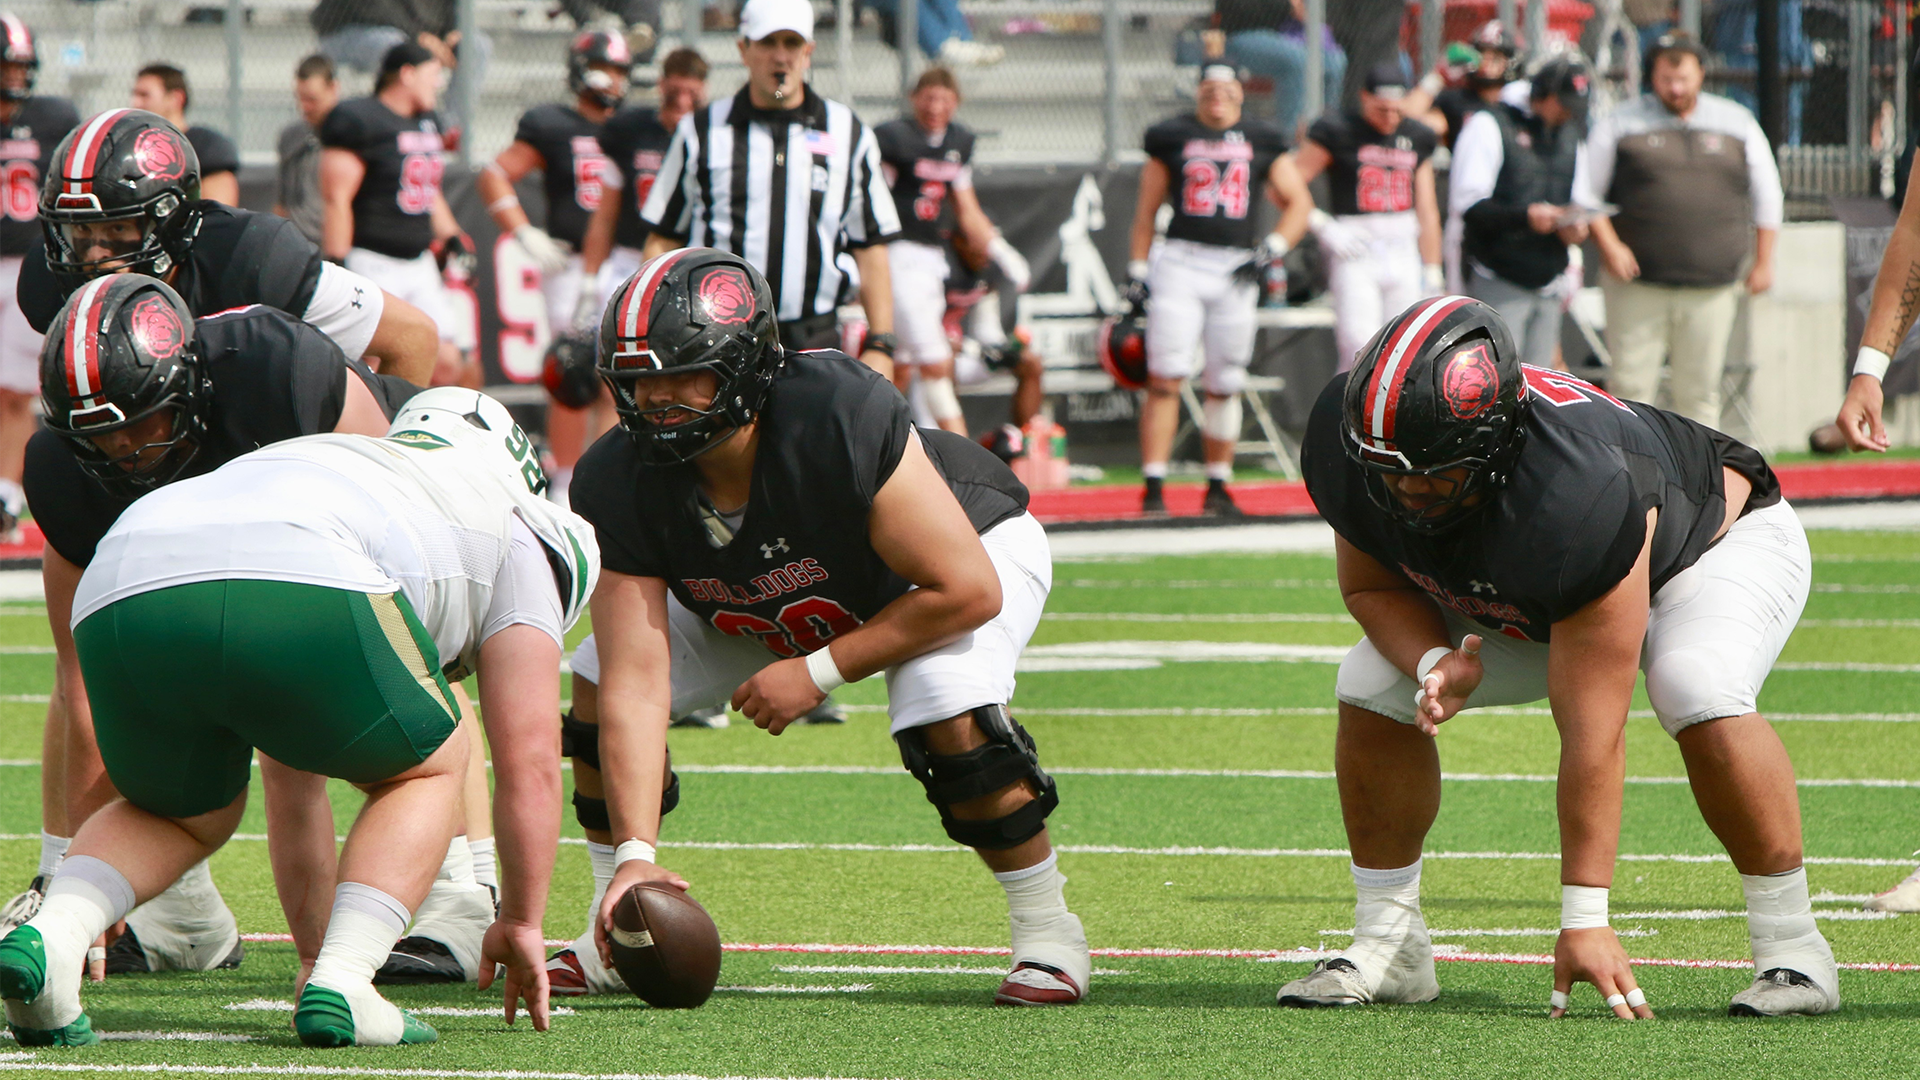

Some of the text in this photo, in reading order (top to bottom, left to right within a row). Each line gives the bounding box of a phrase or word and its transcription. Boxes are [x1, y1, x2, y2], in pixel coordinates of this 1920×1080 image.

[0, 159, 39, 221] 6
[1183, 158, 1249, 218] 24
[505, 421, 542, 494] 92
[681, 557, 829, 605] BULLDOGS
